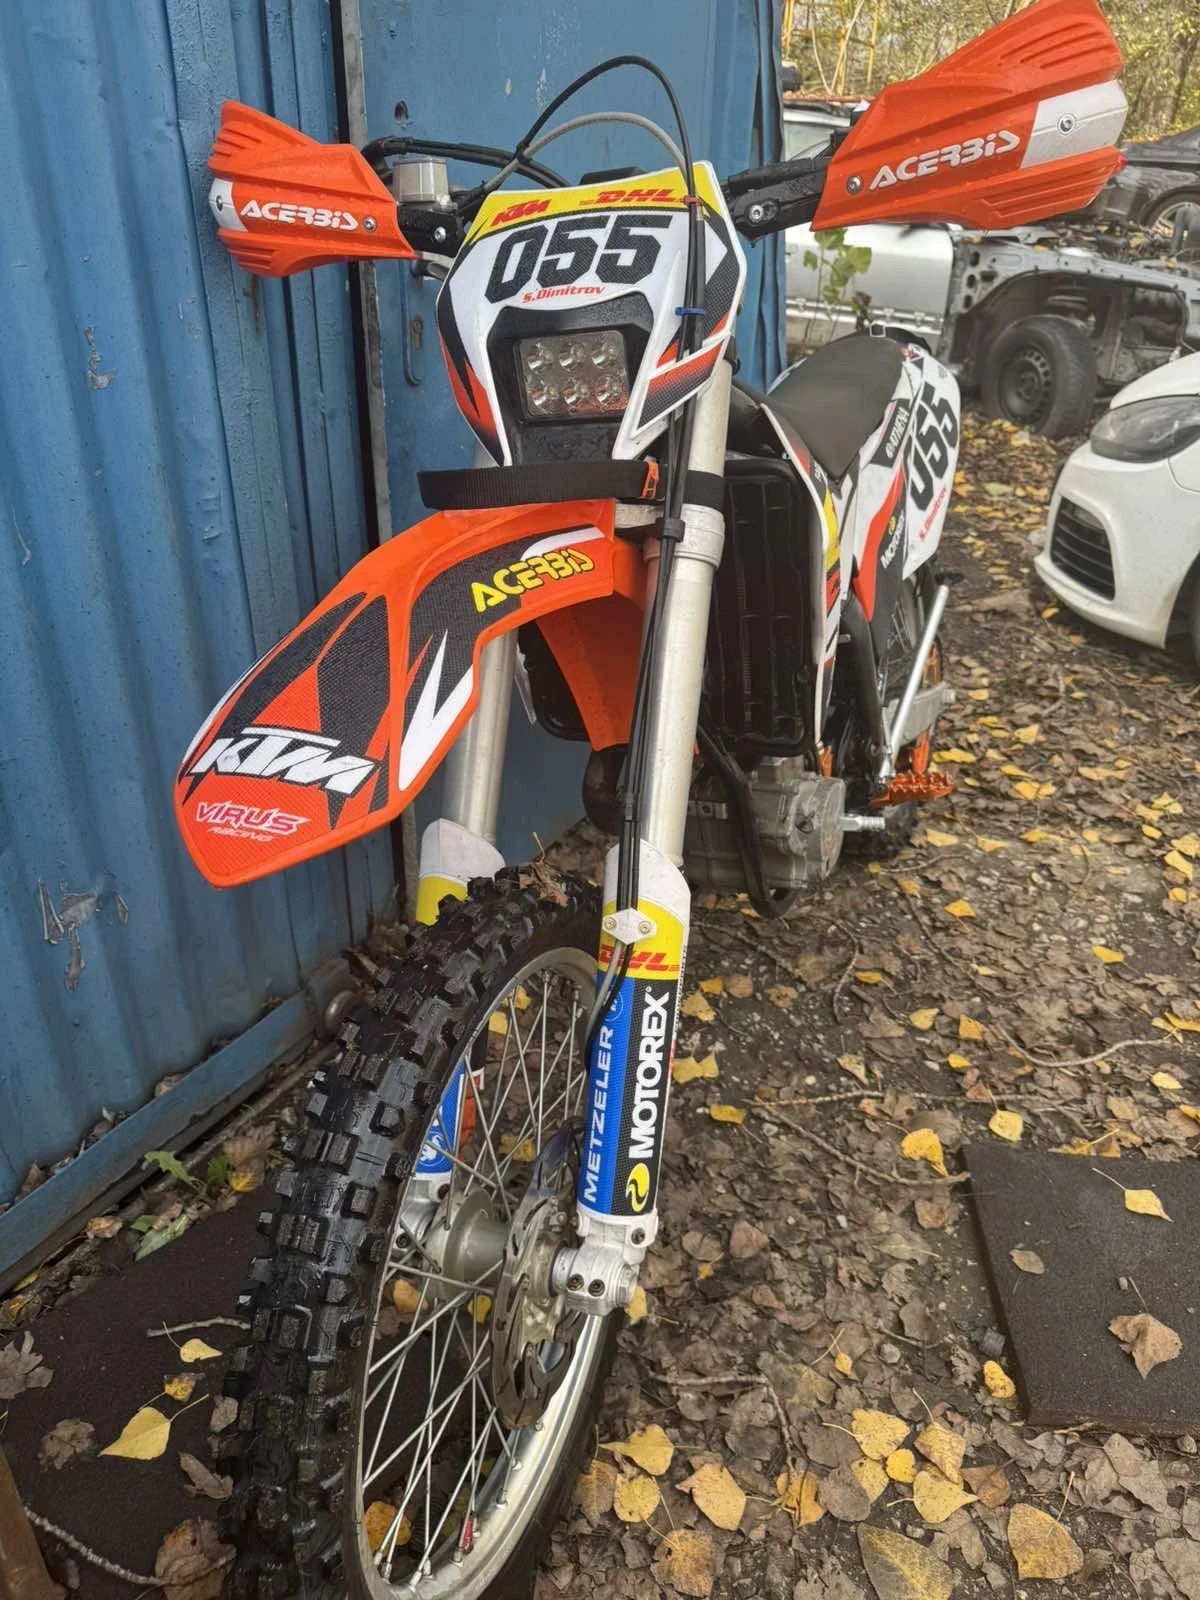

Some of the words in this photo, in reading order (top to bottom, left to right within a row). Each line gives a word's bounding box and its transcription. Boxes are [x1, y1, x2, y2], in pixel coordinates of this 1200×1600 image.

[491, 199, 551, 227] KTM
[594, 188, 676, 205] DHL
[484, 214, 673, 304] 055
[190, 727, 375, 795] KTM
[195, 800, 311, 836] VIRUS
[206, 826, 275, 843] RACING
[628, 991, 670, 1160] MOTOREX
[583, 1027, 614, 1204] METZELER
